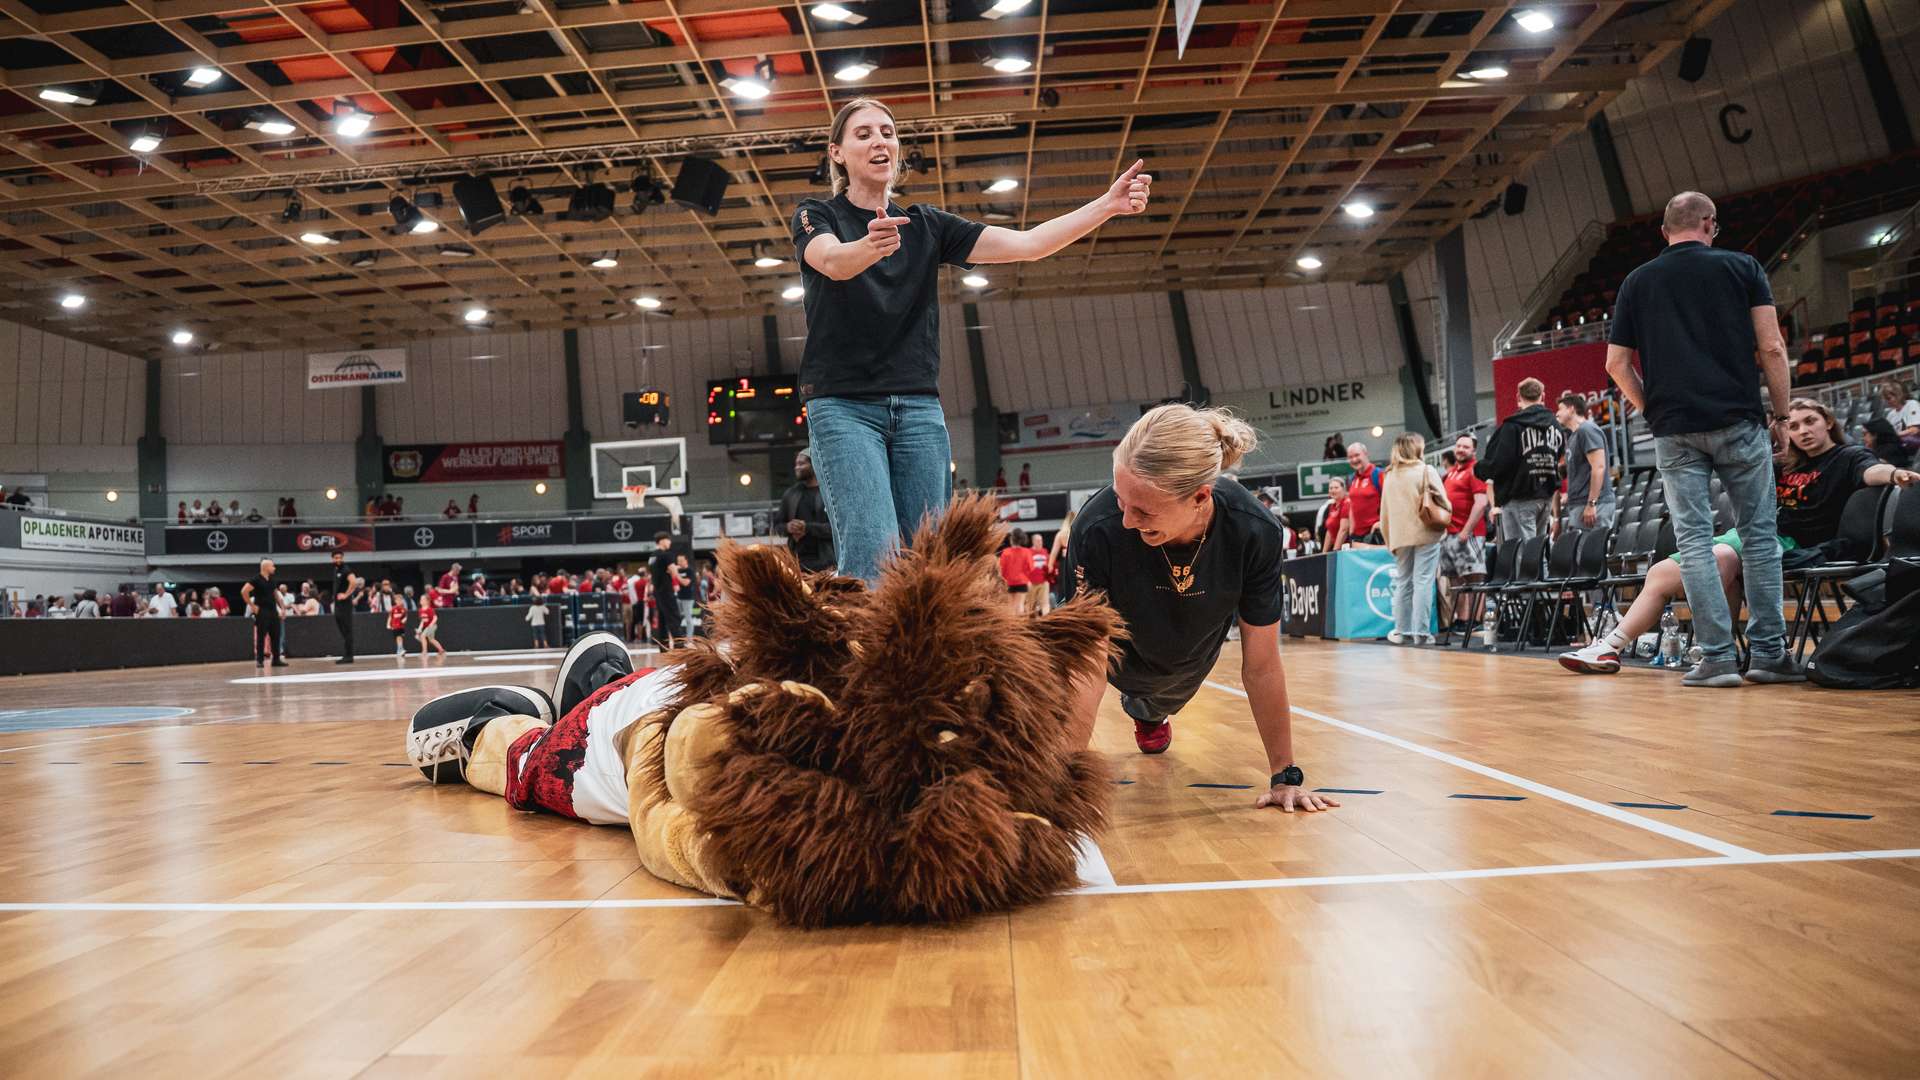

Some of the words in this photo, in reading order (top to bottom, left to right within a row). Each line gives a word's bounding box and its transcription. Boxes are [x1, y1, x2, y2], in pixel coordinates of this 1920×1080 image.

[1719, 103, 1752, 144] C
[23, 521, 85, 538] OPLADENER
[88, 526, 143, 543] APOTHEKE
[302, 535, 335, 547] GoFit
[1290, 578, 1319, 622] Bayer
